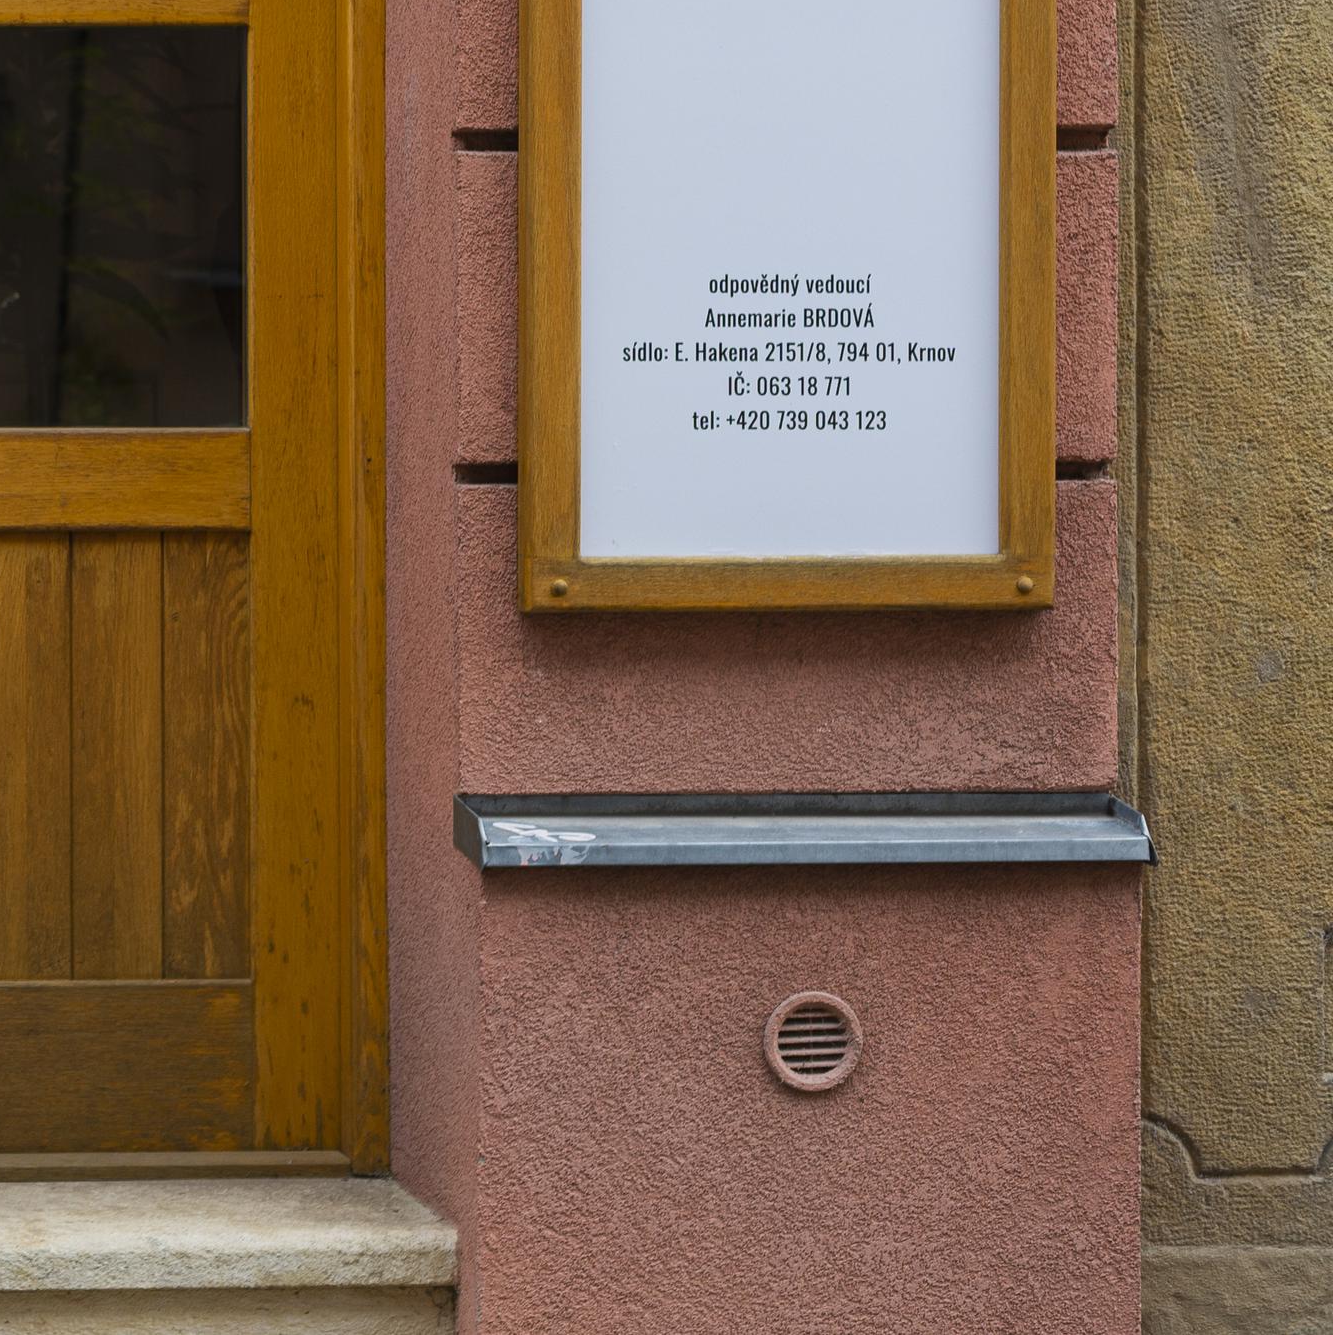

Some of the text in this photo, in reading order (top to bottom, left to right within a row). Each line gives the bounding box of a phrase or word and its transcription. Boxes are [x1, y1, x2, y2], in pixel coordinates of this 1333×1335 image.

[709, 273, 872, 298] odpovědný vedoucí
[704, 302, 875, 328] Annemarie BRDOVÁ
[622, 341, 956, 365] sídlo: E. Hakena 2151/8, 794 01, Krnov
[728, 370, 850, 397] IČ: 063 18 771
[692, 410, 887, 431] tel: +420 739 043 123
